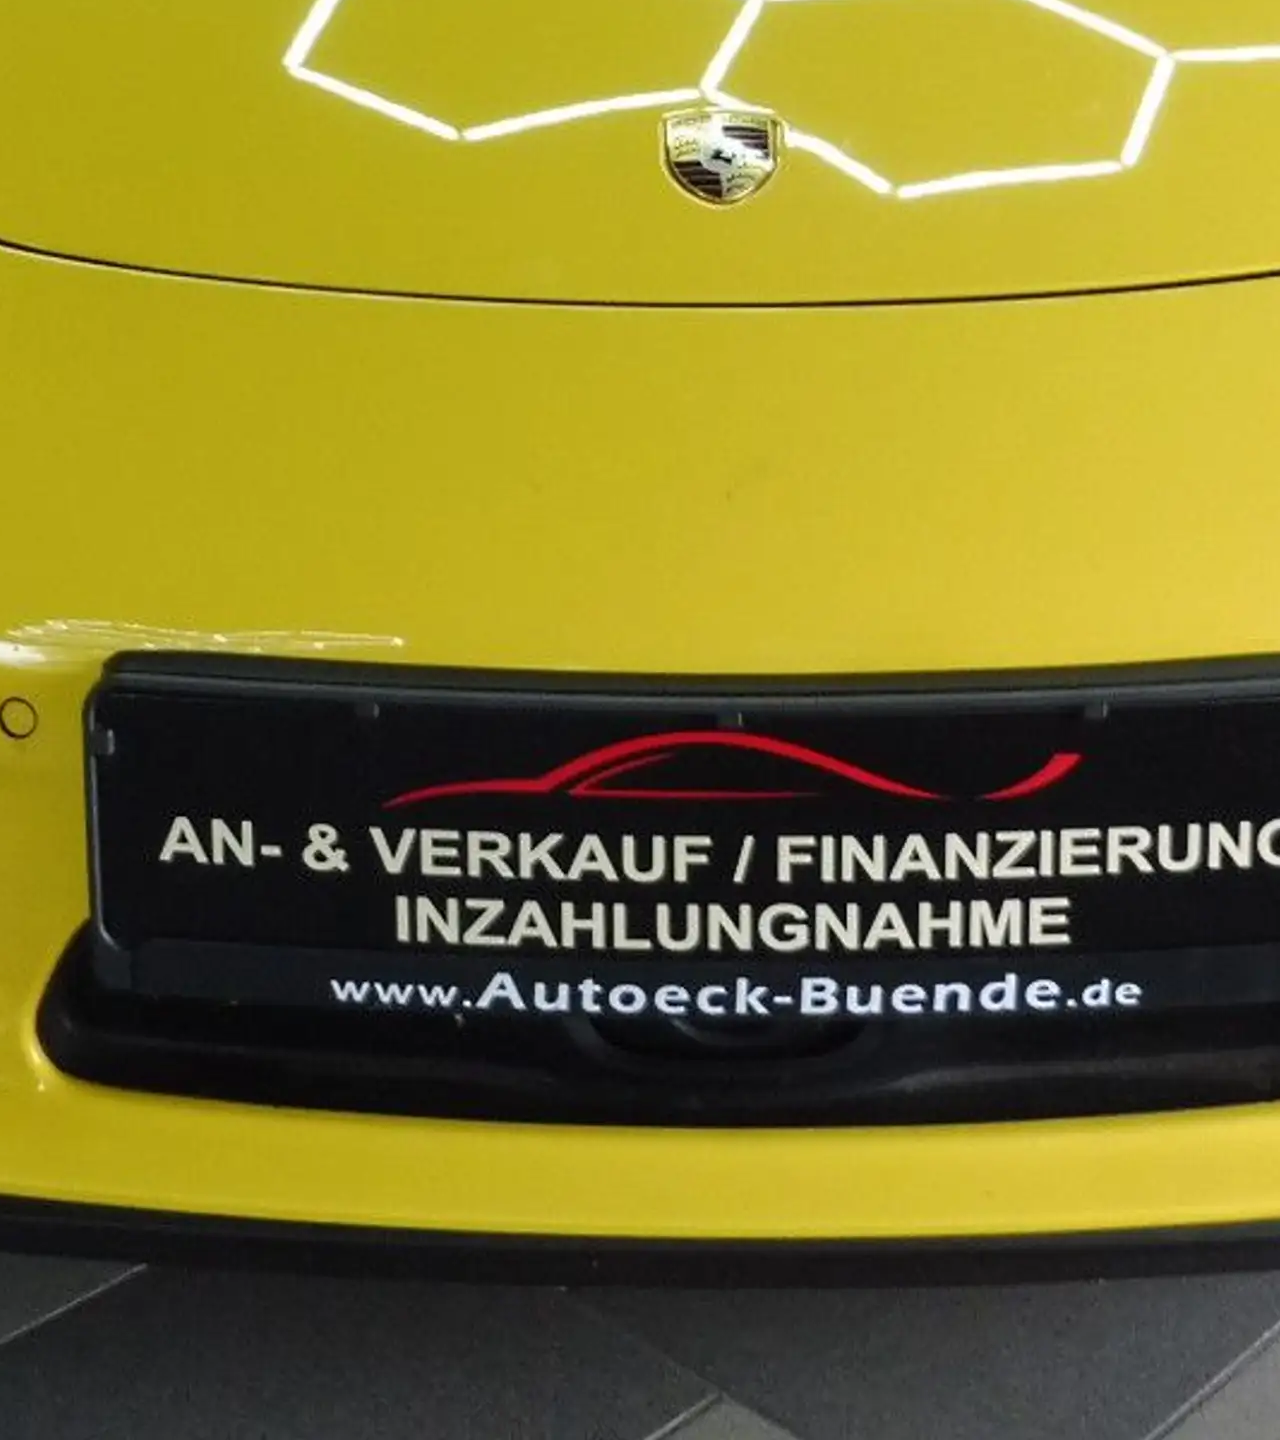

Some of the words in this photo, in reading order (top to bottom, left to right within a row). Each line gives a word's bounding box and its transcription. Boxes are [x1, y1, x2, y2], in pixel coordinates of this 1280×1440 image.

[158, 815, 282, 866] AN-
[300, 823, 350, 872] &
[369, 826, 712, 883] VERKAUF
[732, 835, 755, 883] /
[394, 895, 1071, 952] INZAHLUNGNAHME
[330, 971, 1144, 1016] www.Autoeck-Buende.de
